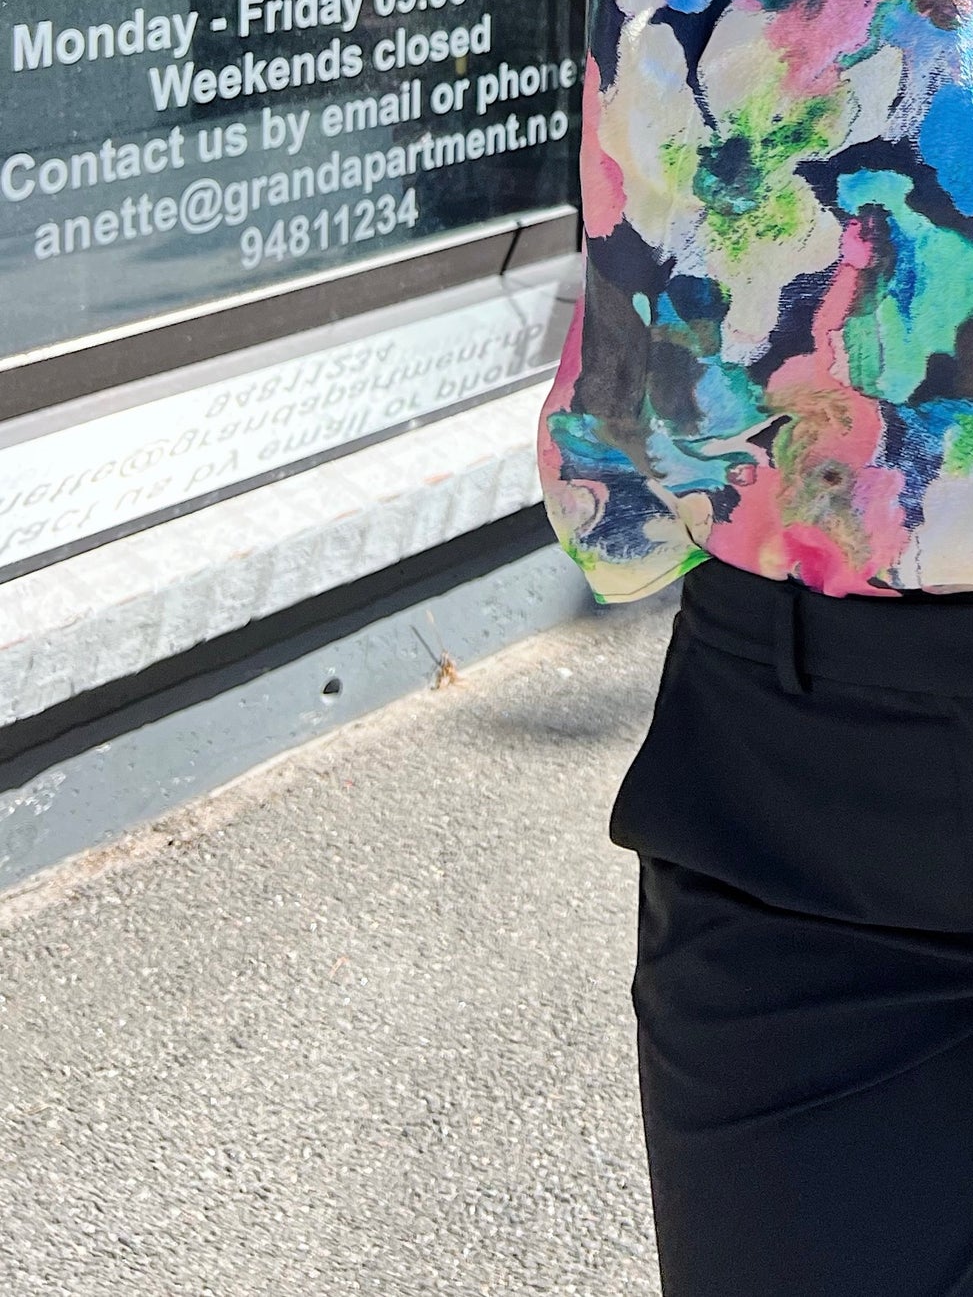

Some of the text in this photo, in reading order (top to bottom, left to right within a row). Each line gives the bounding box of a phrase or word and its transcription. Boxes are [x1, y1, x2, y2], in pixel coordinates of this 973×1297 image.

[12, 7, 199, 72] Monday
[149, 12, 491, 111] Weekends closed
[1, 125, 185, 202] Contact
[198, 122, 248, 163] us
[262, 106, 311, 156] by
[321, 78, 422, 137] email
[430, 78, 470, 114] or
[34, 109, 568, 260] anette@grandapartment.no
[241, 186, 419, 271] 94811234
